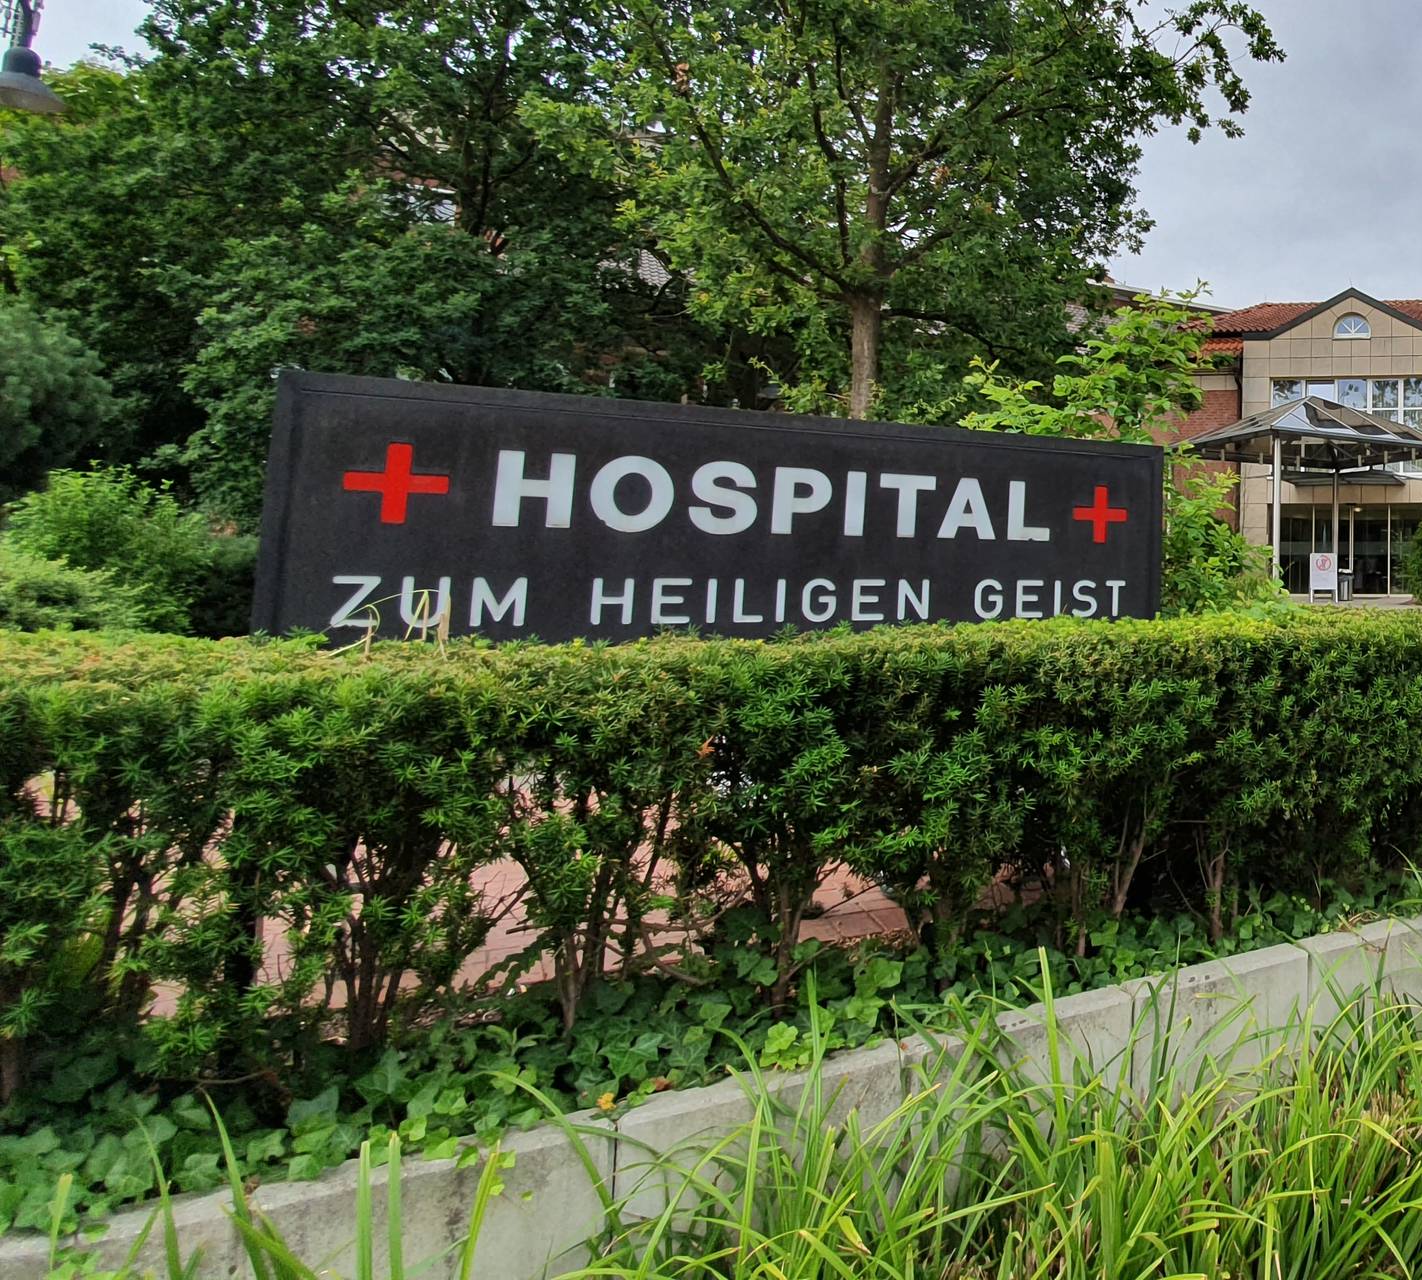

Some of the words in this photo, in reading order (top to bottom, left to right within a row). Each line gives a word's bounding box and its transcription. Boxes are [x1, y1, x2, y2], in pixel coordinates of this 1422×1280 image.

[491, 449, 1050, 542] HOSPITAL
[329, 575, 529, 628] ZUM
[589, 577, 931, 626] HEILIGEN
[974, 578, 1127, 621] GEIST
